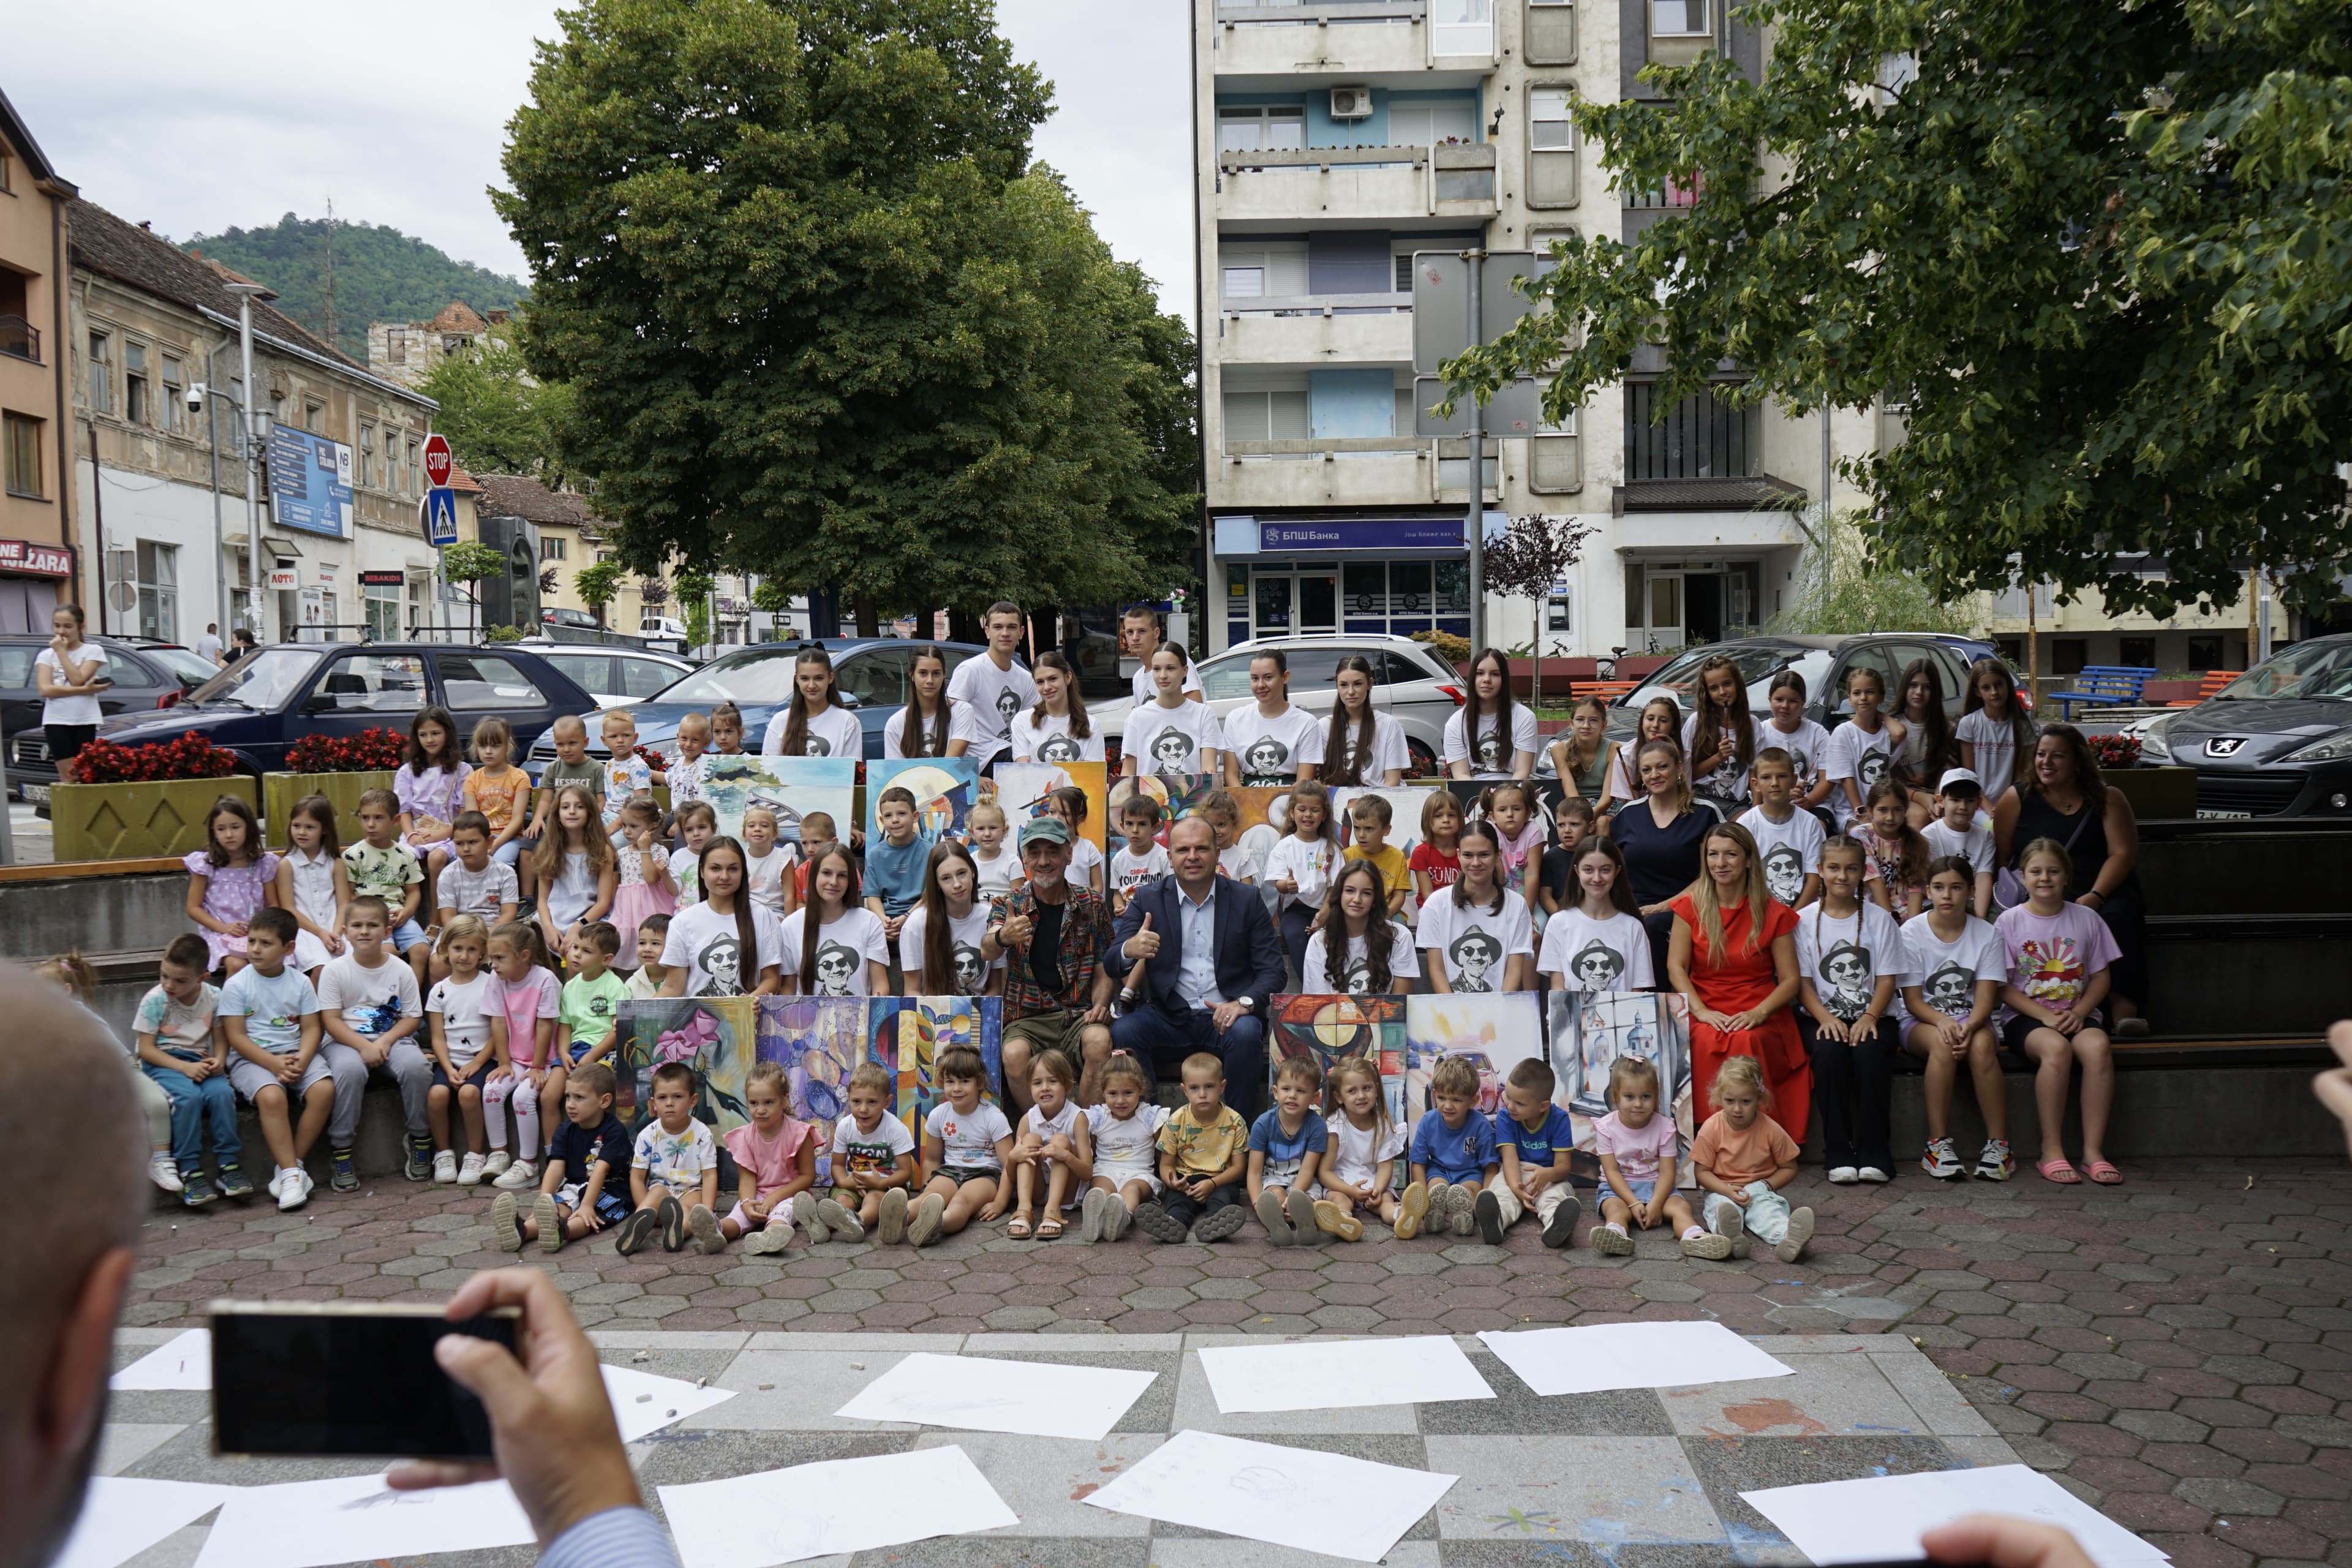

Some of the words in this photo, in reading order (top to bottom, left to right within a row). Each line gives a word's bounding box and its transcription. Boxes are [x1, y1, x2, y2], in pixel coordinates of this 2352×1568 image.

[340, 451, 349, 466] NB
[428, 453, 448, 470] STOP
[1283, 531, 1308, 540] БПШ
[1309, 531, 1340, 540] Банка
[0, 544, 20, 557] NE
[554, 777, 591, 788] RESPECT
[1119, 874, 1139, 887] YOUR
[1140, 872, 1162, 884] MIND
[1428, 866, 1460, 884] SÜND
[1463, 1136, 1477, 1153] NY
